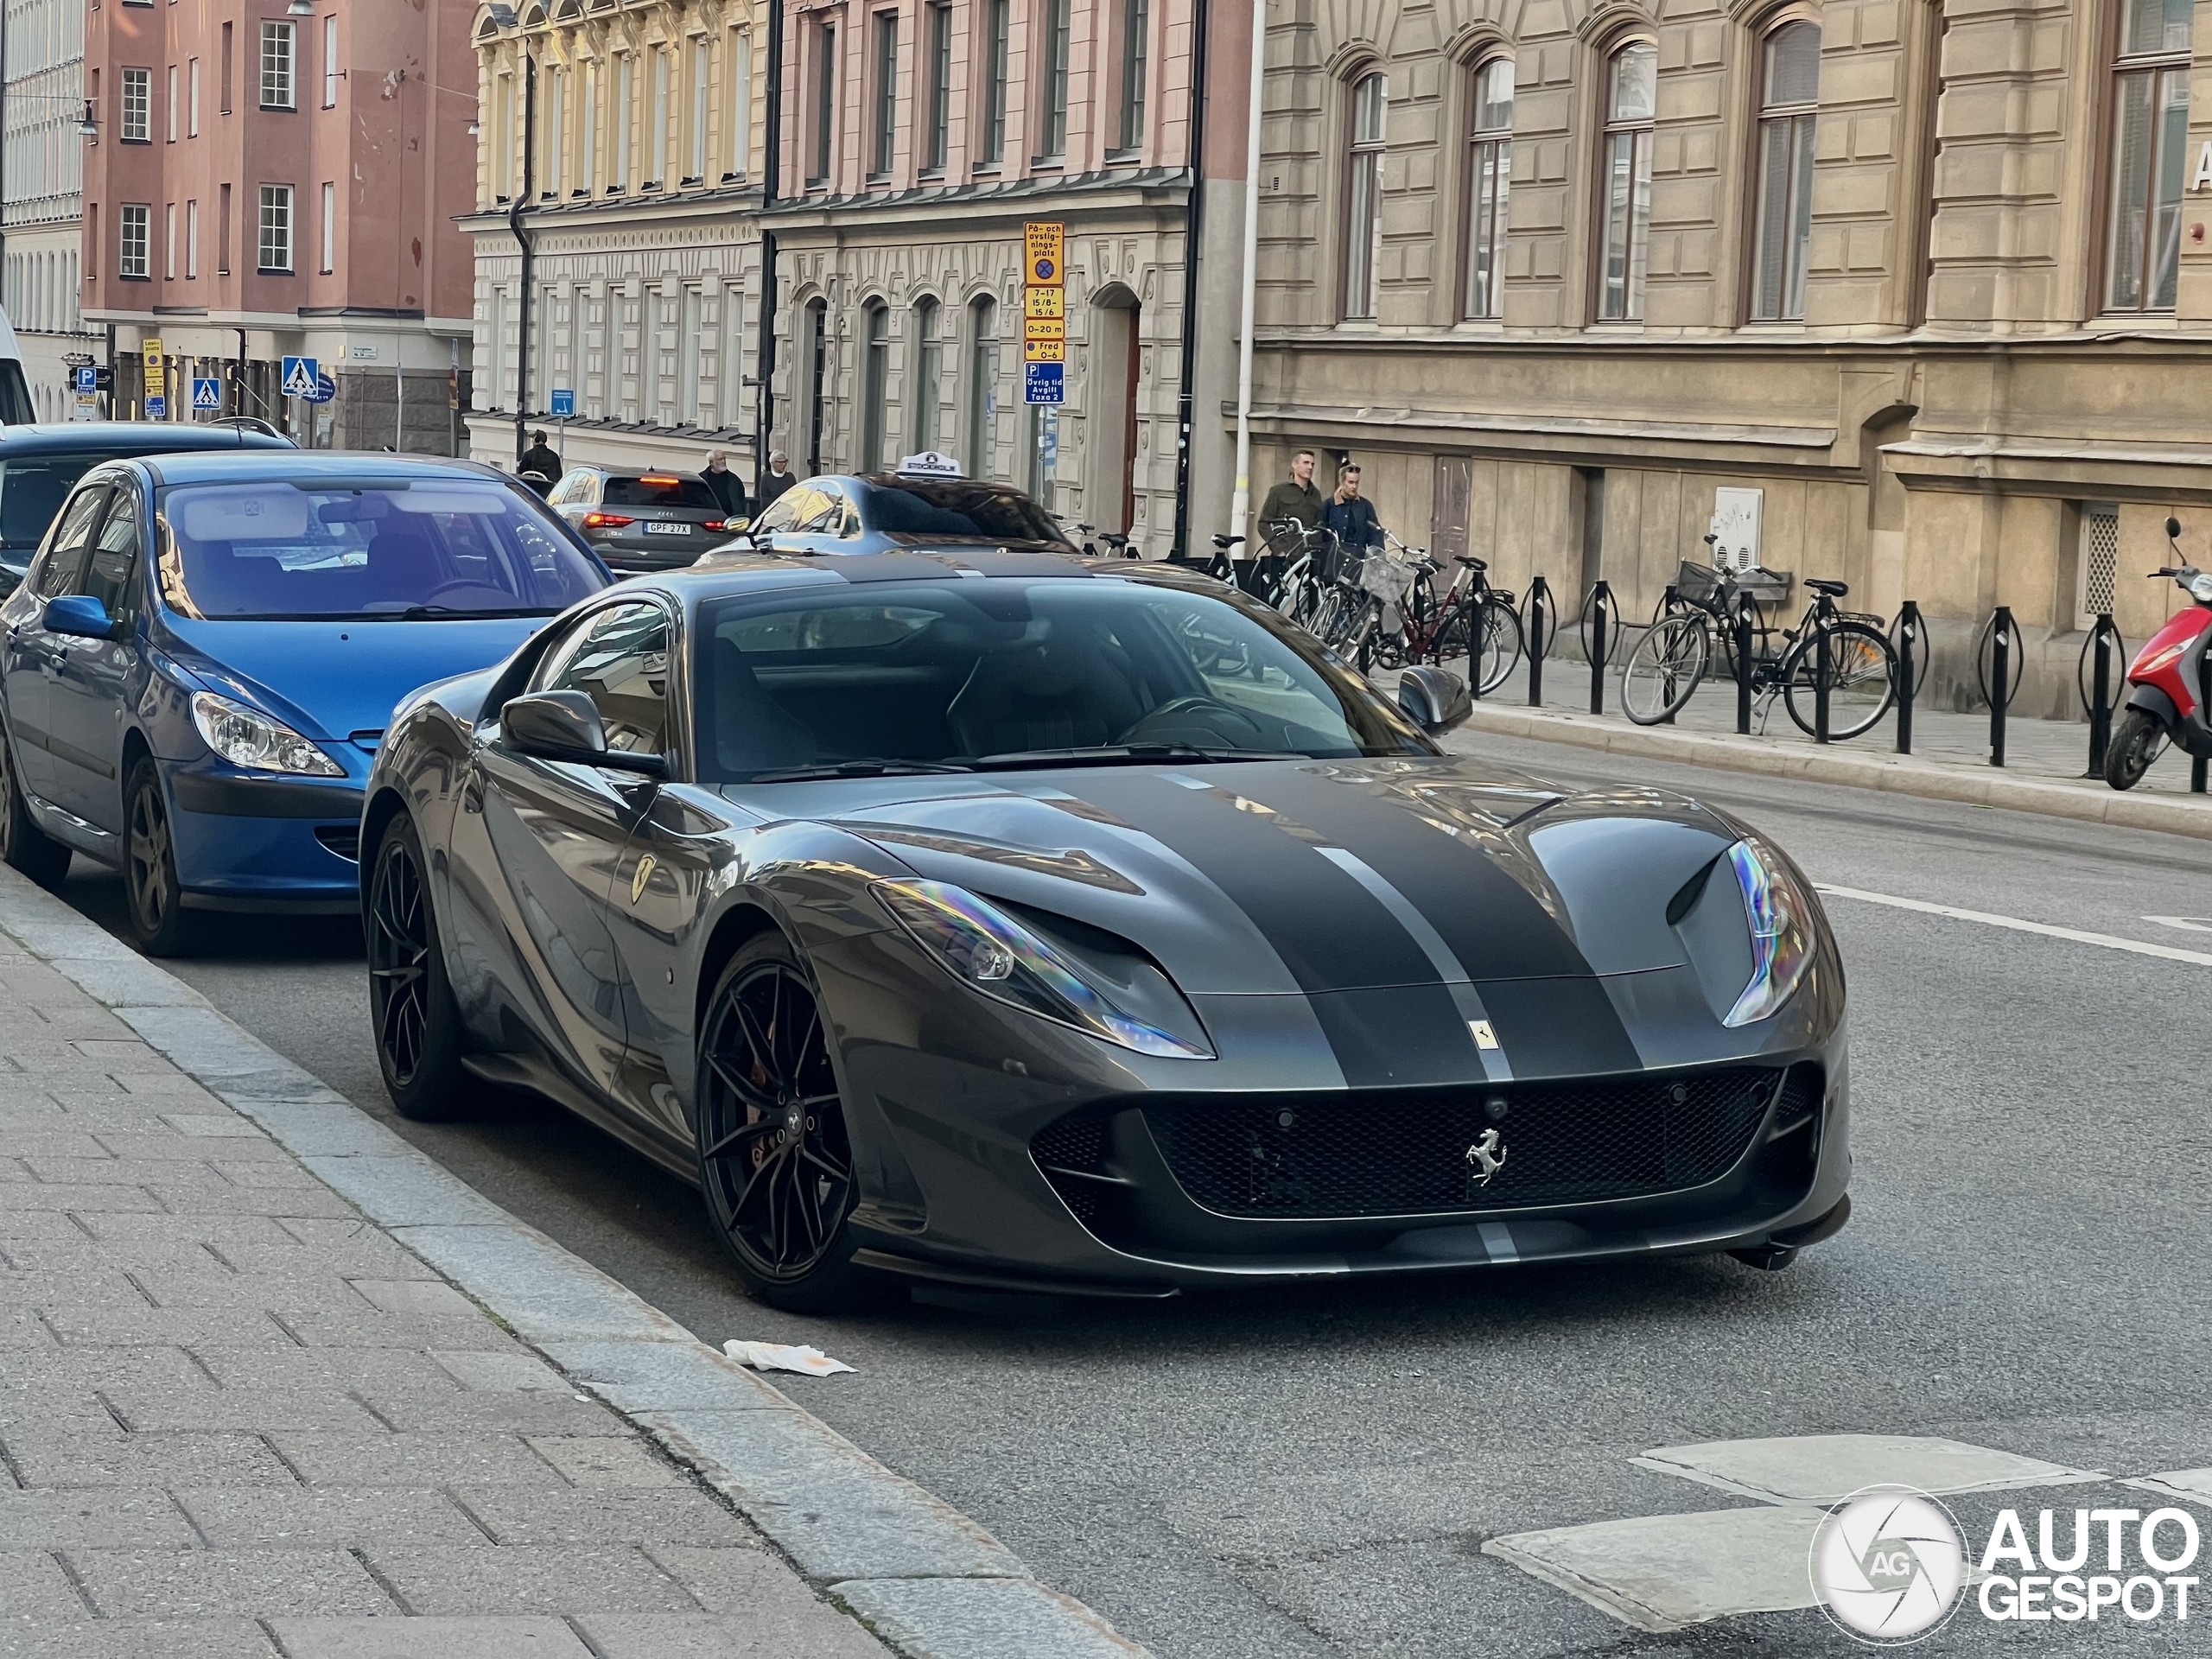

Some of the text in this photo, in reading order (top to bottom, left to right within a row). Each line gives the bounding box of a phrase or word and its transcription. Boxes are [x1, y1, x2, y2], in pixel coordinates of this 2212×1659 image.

[1029, 232, 1059, 241] avstig-
[1031, 241, 1058, 250] nings-
[1029, 365, 1037, 375] P
[82, 369, 93, 385] P
[1027, 378, 1049, 386] Övrig
[671, 524, 687, 533] 27X
